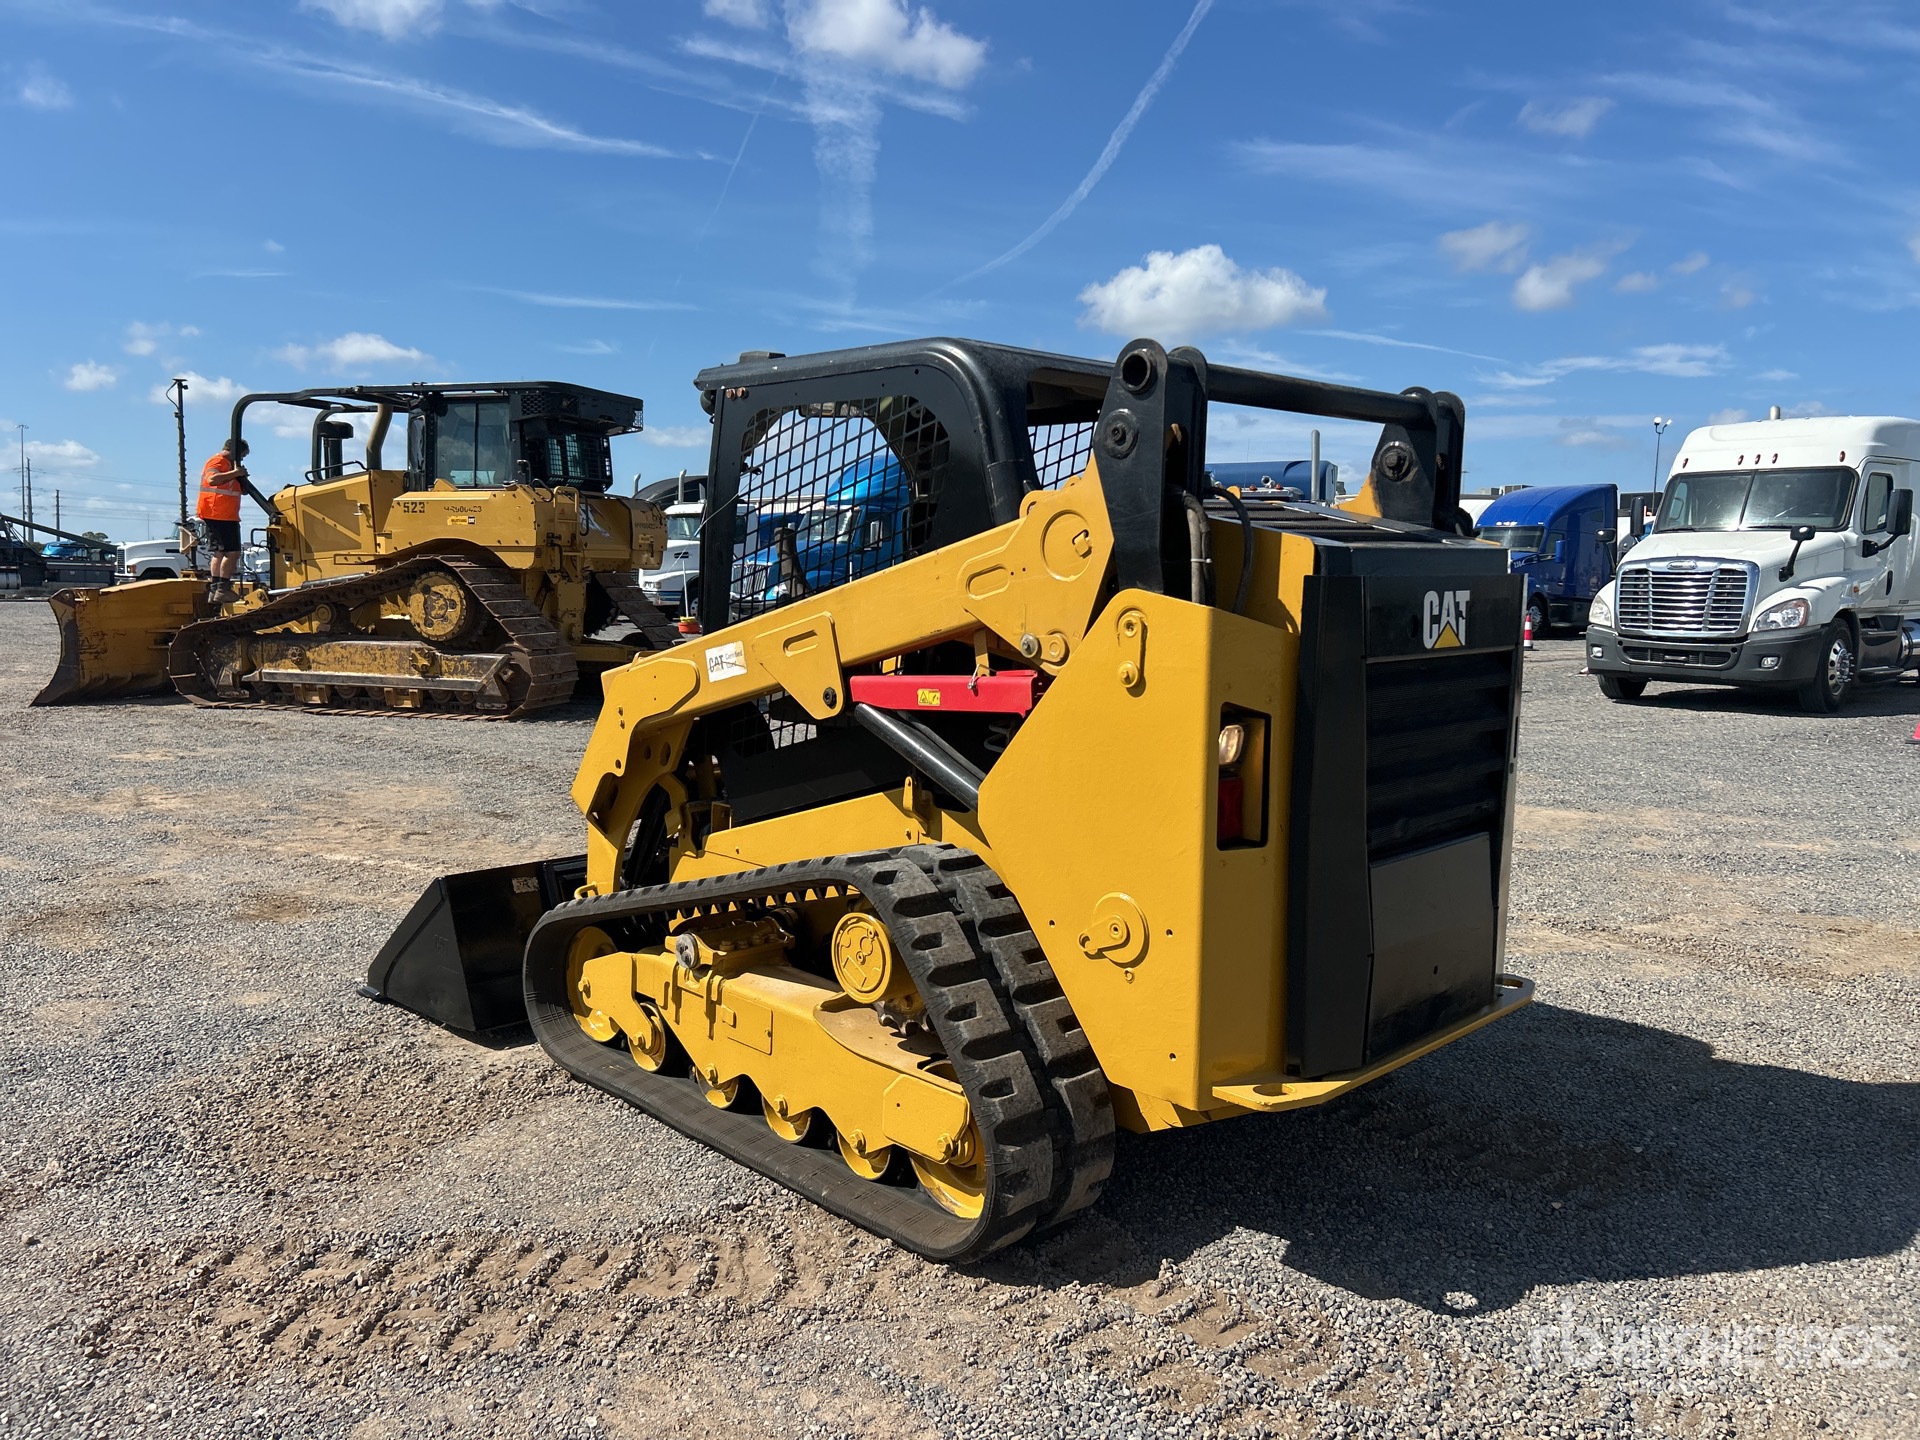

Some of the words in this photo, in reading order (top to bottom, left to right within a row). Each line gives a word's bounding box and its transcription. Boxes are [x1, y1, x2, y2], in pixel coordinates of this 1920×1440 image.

[403, 501, 426, 513] 523
[1423, 590, 1470, 649] CAT
[709, 655, 724, 673] CAT
